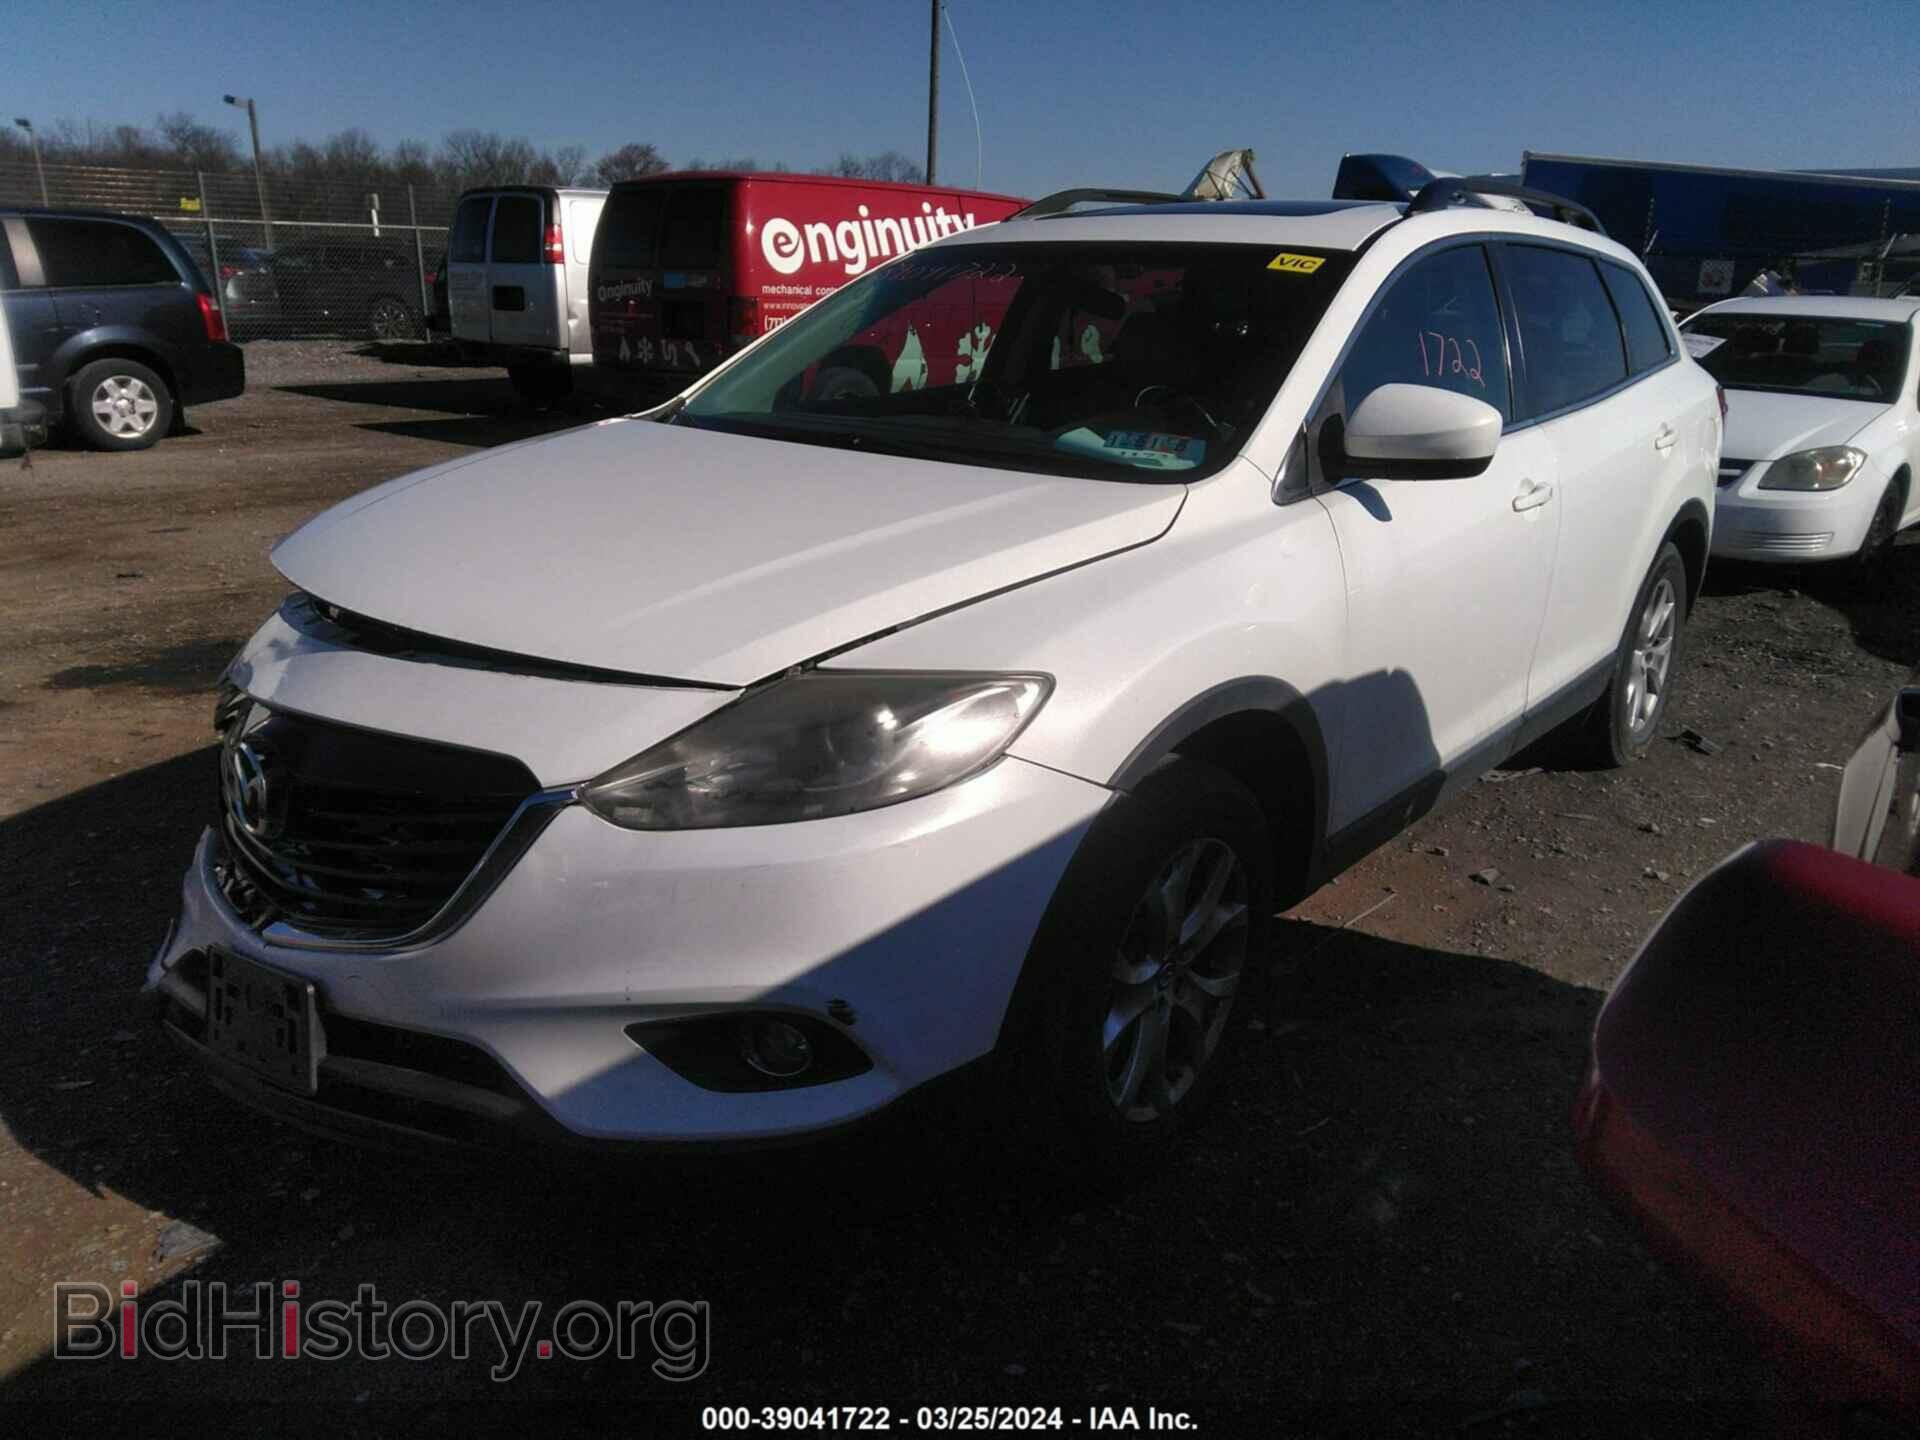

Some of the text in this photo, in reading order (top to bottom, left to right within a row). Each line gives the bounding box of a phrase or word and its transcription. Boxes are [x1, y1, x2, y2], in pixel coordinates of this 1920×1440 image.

[1278, 256, 1318, 270] VIC
[762, 284, 813, 296] mechanical
[1418, 330, 1485, 388] 1722
